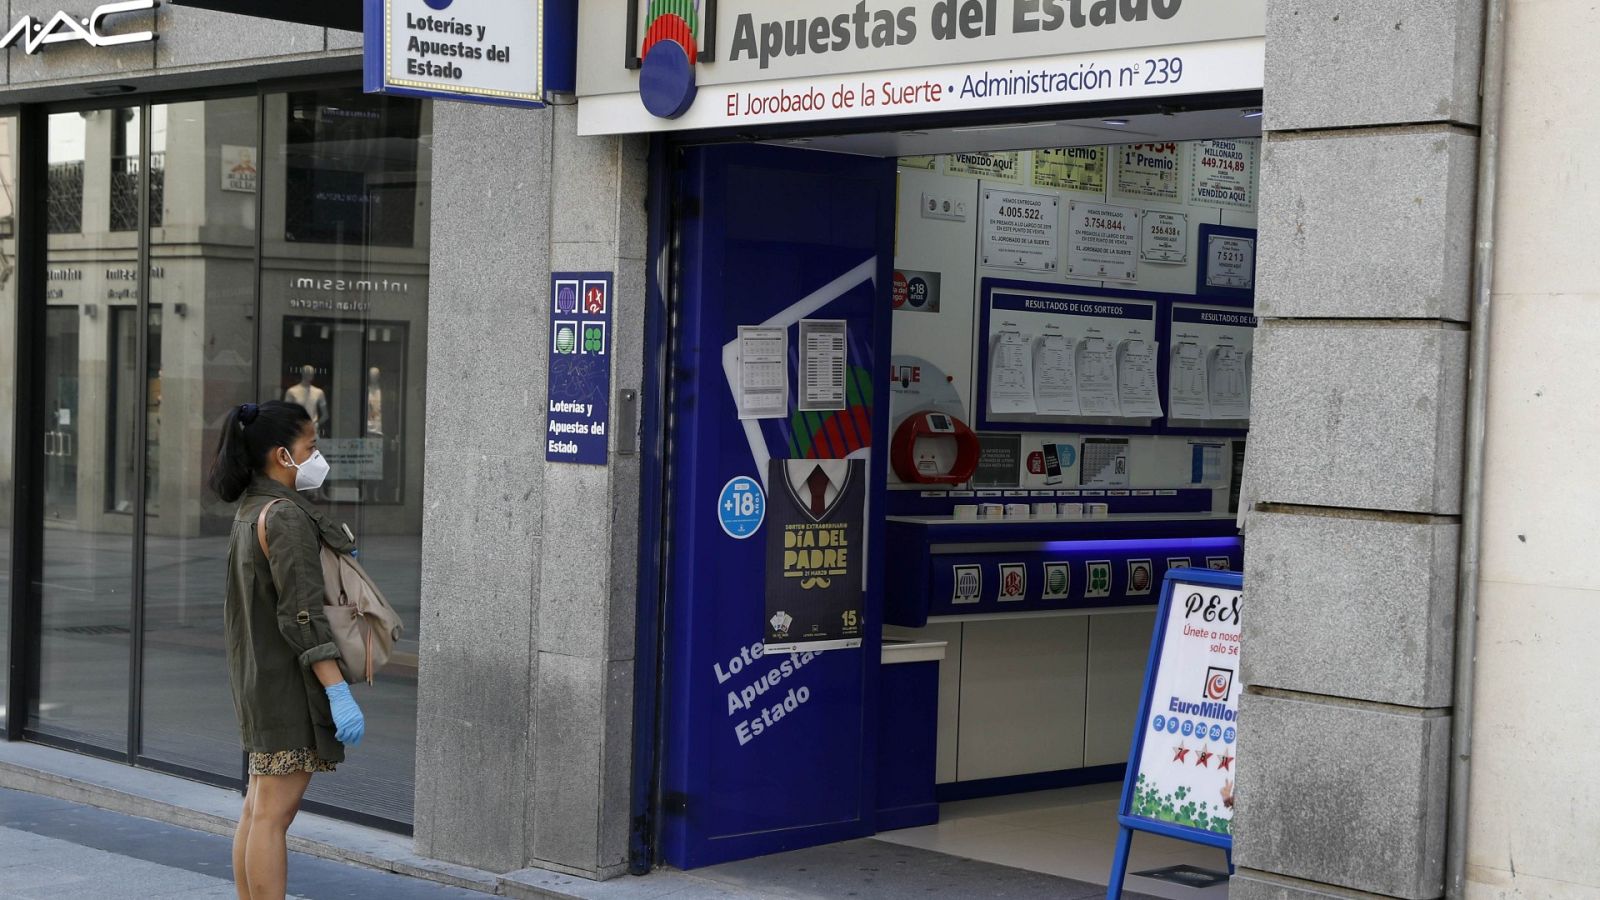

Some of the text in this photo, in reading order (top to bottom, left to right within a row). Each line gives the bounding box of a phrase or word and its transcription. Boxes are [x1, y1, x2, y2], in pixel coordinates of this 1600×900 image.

[407, 12, 486, 42] Loterías y
[729, 0, 917, 69] Apuestas
[931, 0, 996, 40] del
[407, 36, 510, 62] Apuestas del
[407, 58, 463, 79] Estado
[727, 92, 739, 116] El
[744, 86, 826, 115] Jorobado
[832, 84, 855, 109] de
[861, 82, 875, 107] la
[882, 81, 942, 105] Suerte
[960, 63, 1112, 98] Administración
[1144, 57, 1183, 85] 239
[1212, 140, 1236, 150] PREMIO
[1137, 154, 1173, 169] Premio
[1204, 147, 1243, 160] MILLONARIO
[956, 154, 1013, 170] VENDIDO AQUÍ
[1201, 157, 1245, 172] 449.714,89
[1198, 187, 1228, 199] VENDIDO
[999, 206, 1040, 219] 4.005.522
[1084, 216, 1122, 230] 3.754.844
[1151, 225, 1176, 235] 256.438
[910, 283, 925, 295] +18
[1025, 299, 1123, 315] RESULTADOS DE LOS SORTEOS
[1200, 312, 1239, 323] RESULTADOS
[1239, 315, 1248, 323] DE
[550, 399, 593, 417] Loterías y
[549, 420, 605, 435] Apuestas del
[548, 440, 578, 454] Estado
[724, 492, 754, 516] +18
[819, 529, 848, 547] DEL
[784, 548, 847, 570] PADRE
[841, 610, 857, 627] 15
[1183, 622, 1209, 638] Únete
[1210, 631, 1217, 639] a
[1209, 643, 1239, 655] solo 5€
[734, 686, 810, 746] Estado
[1156, 718, 1235, 740] 2 9 13 20 28 33
[1178, 747, 1229, 766] 7 8 11
